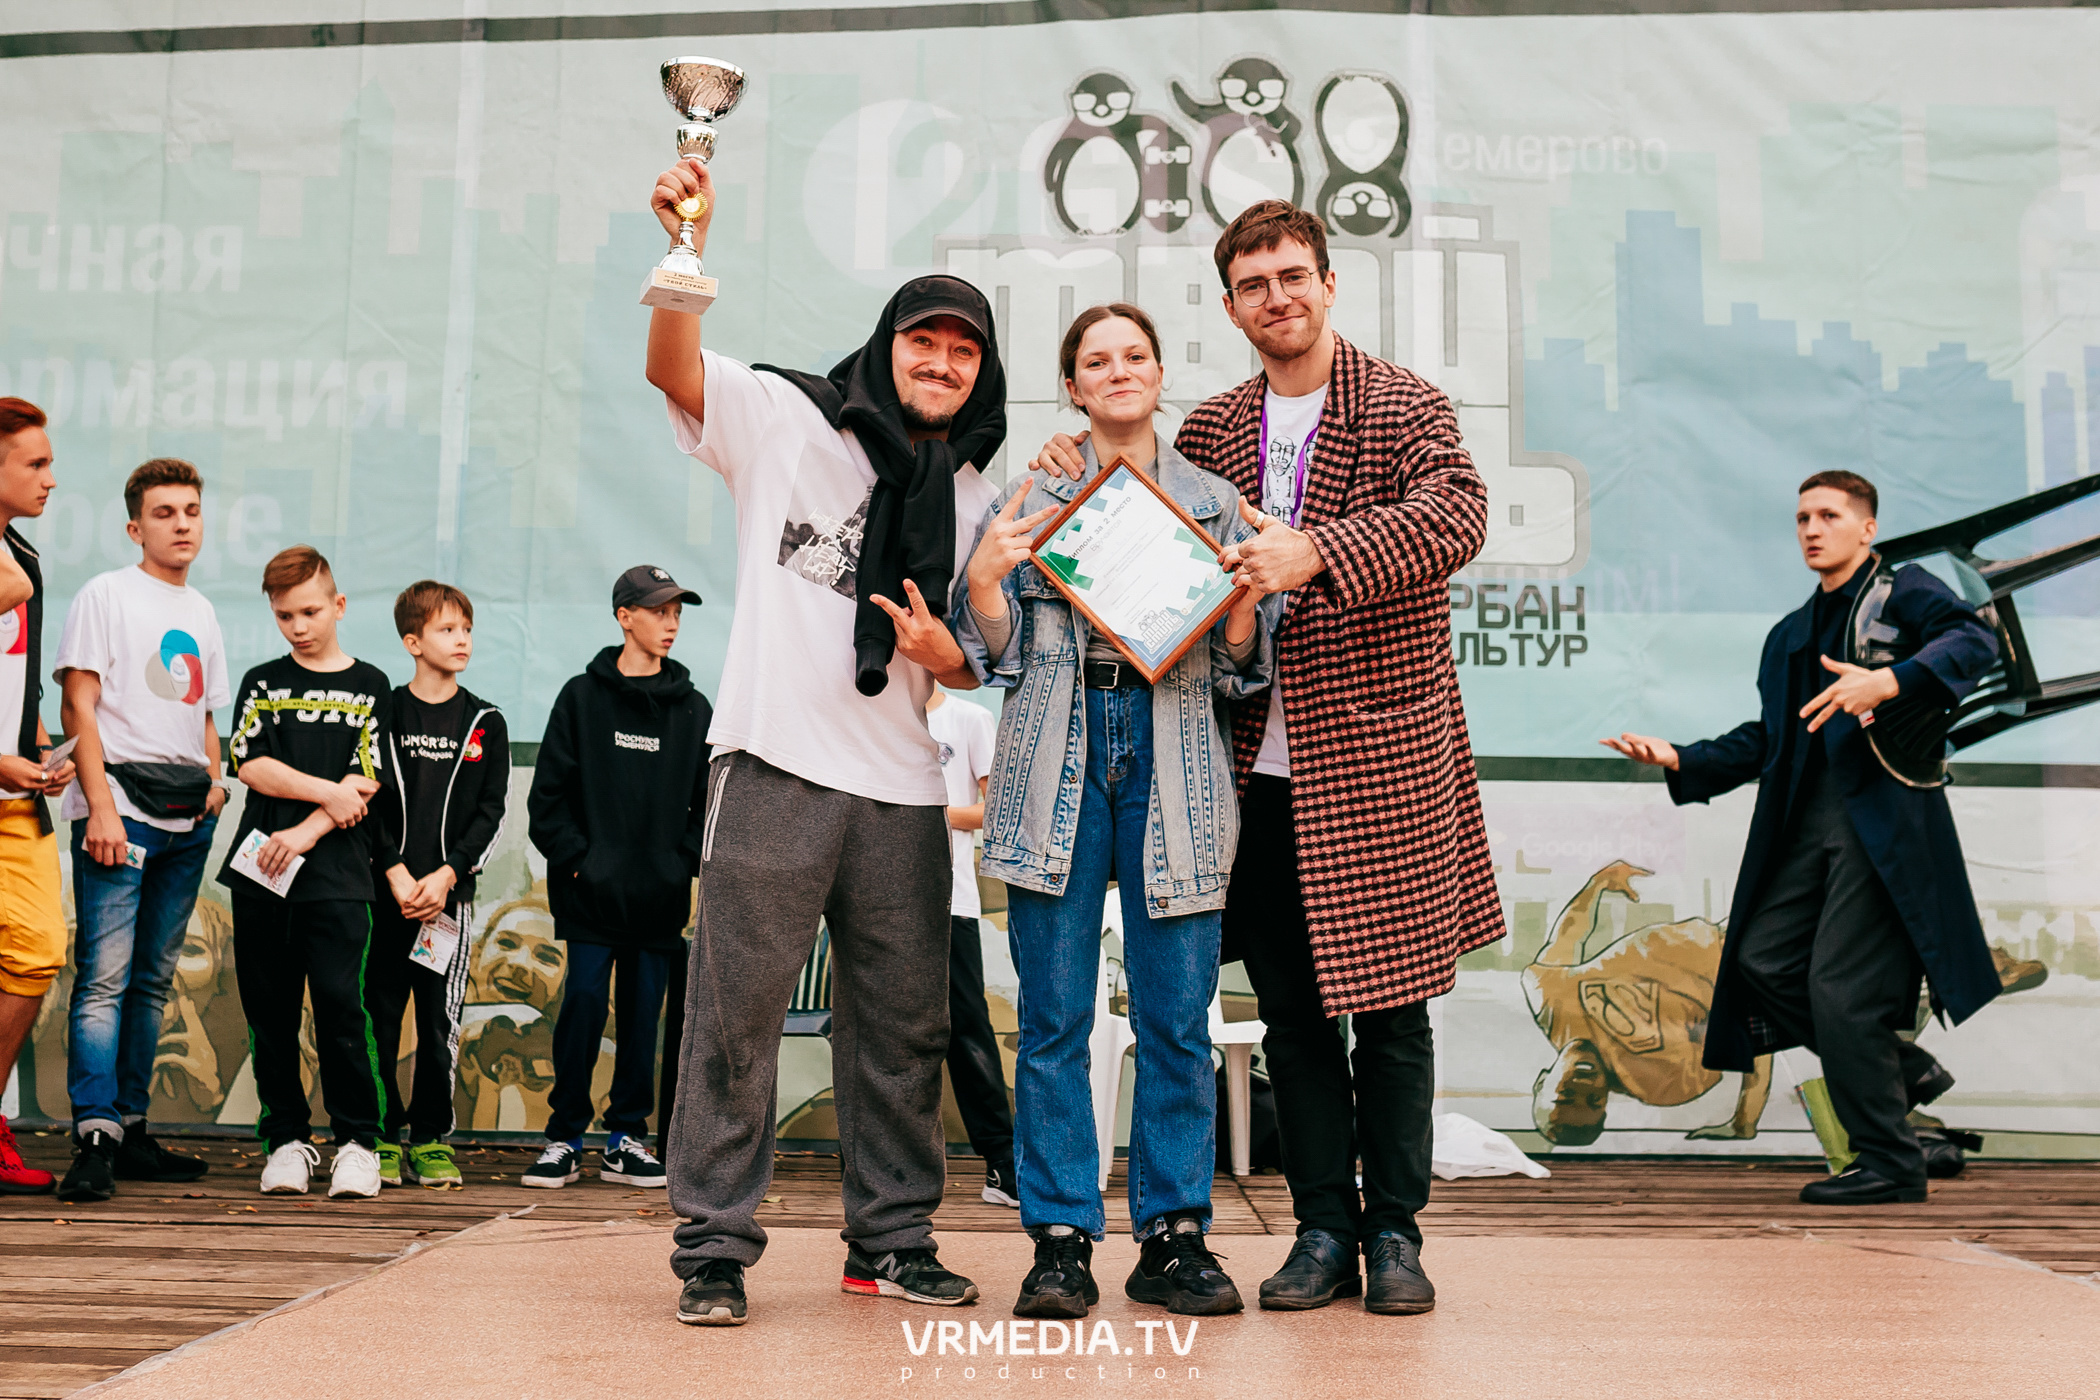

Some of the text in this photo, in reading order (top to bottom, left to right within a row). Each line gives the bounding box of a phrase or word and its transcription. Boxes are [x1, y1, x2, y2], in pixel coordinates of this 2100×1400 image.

[1441, 131, 1670, 181] емерово
[1, 223, 244, 293] чная
[0, 356, 408, 443] рмация
[1067, 496, 1132, 563] Диплом за 2 место
[1450, 583, 1586, 631] РБАН
[1451, 632, 1588, 668] ЛЬТУР
